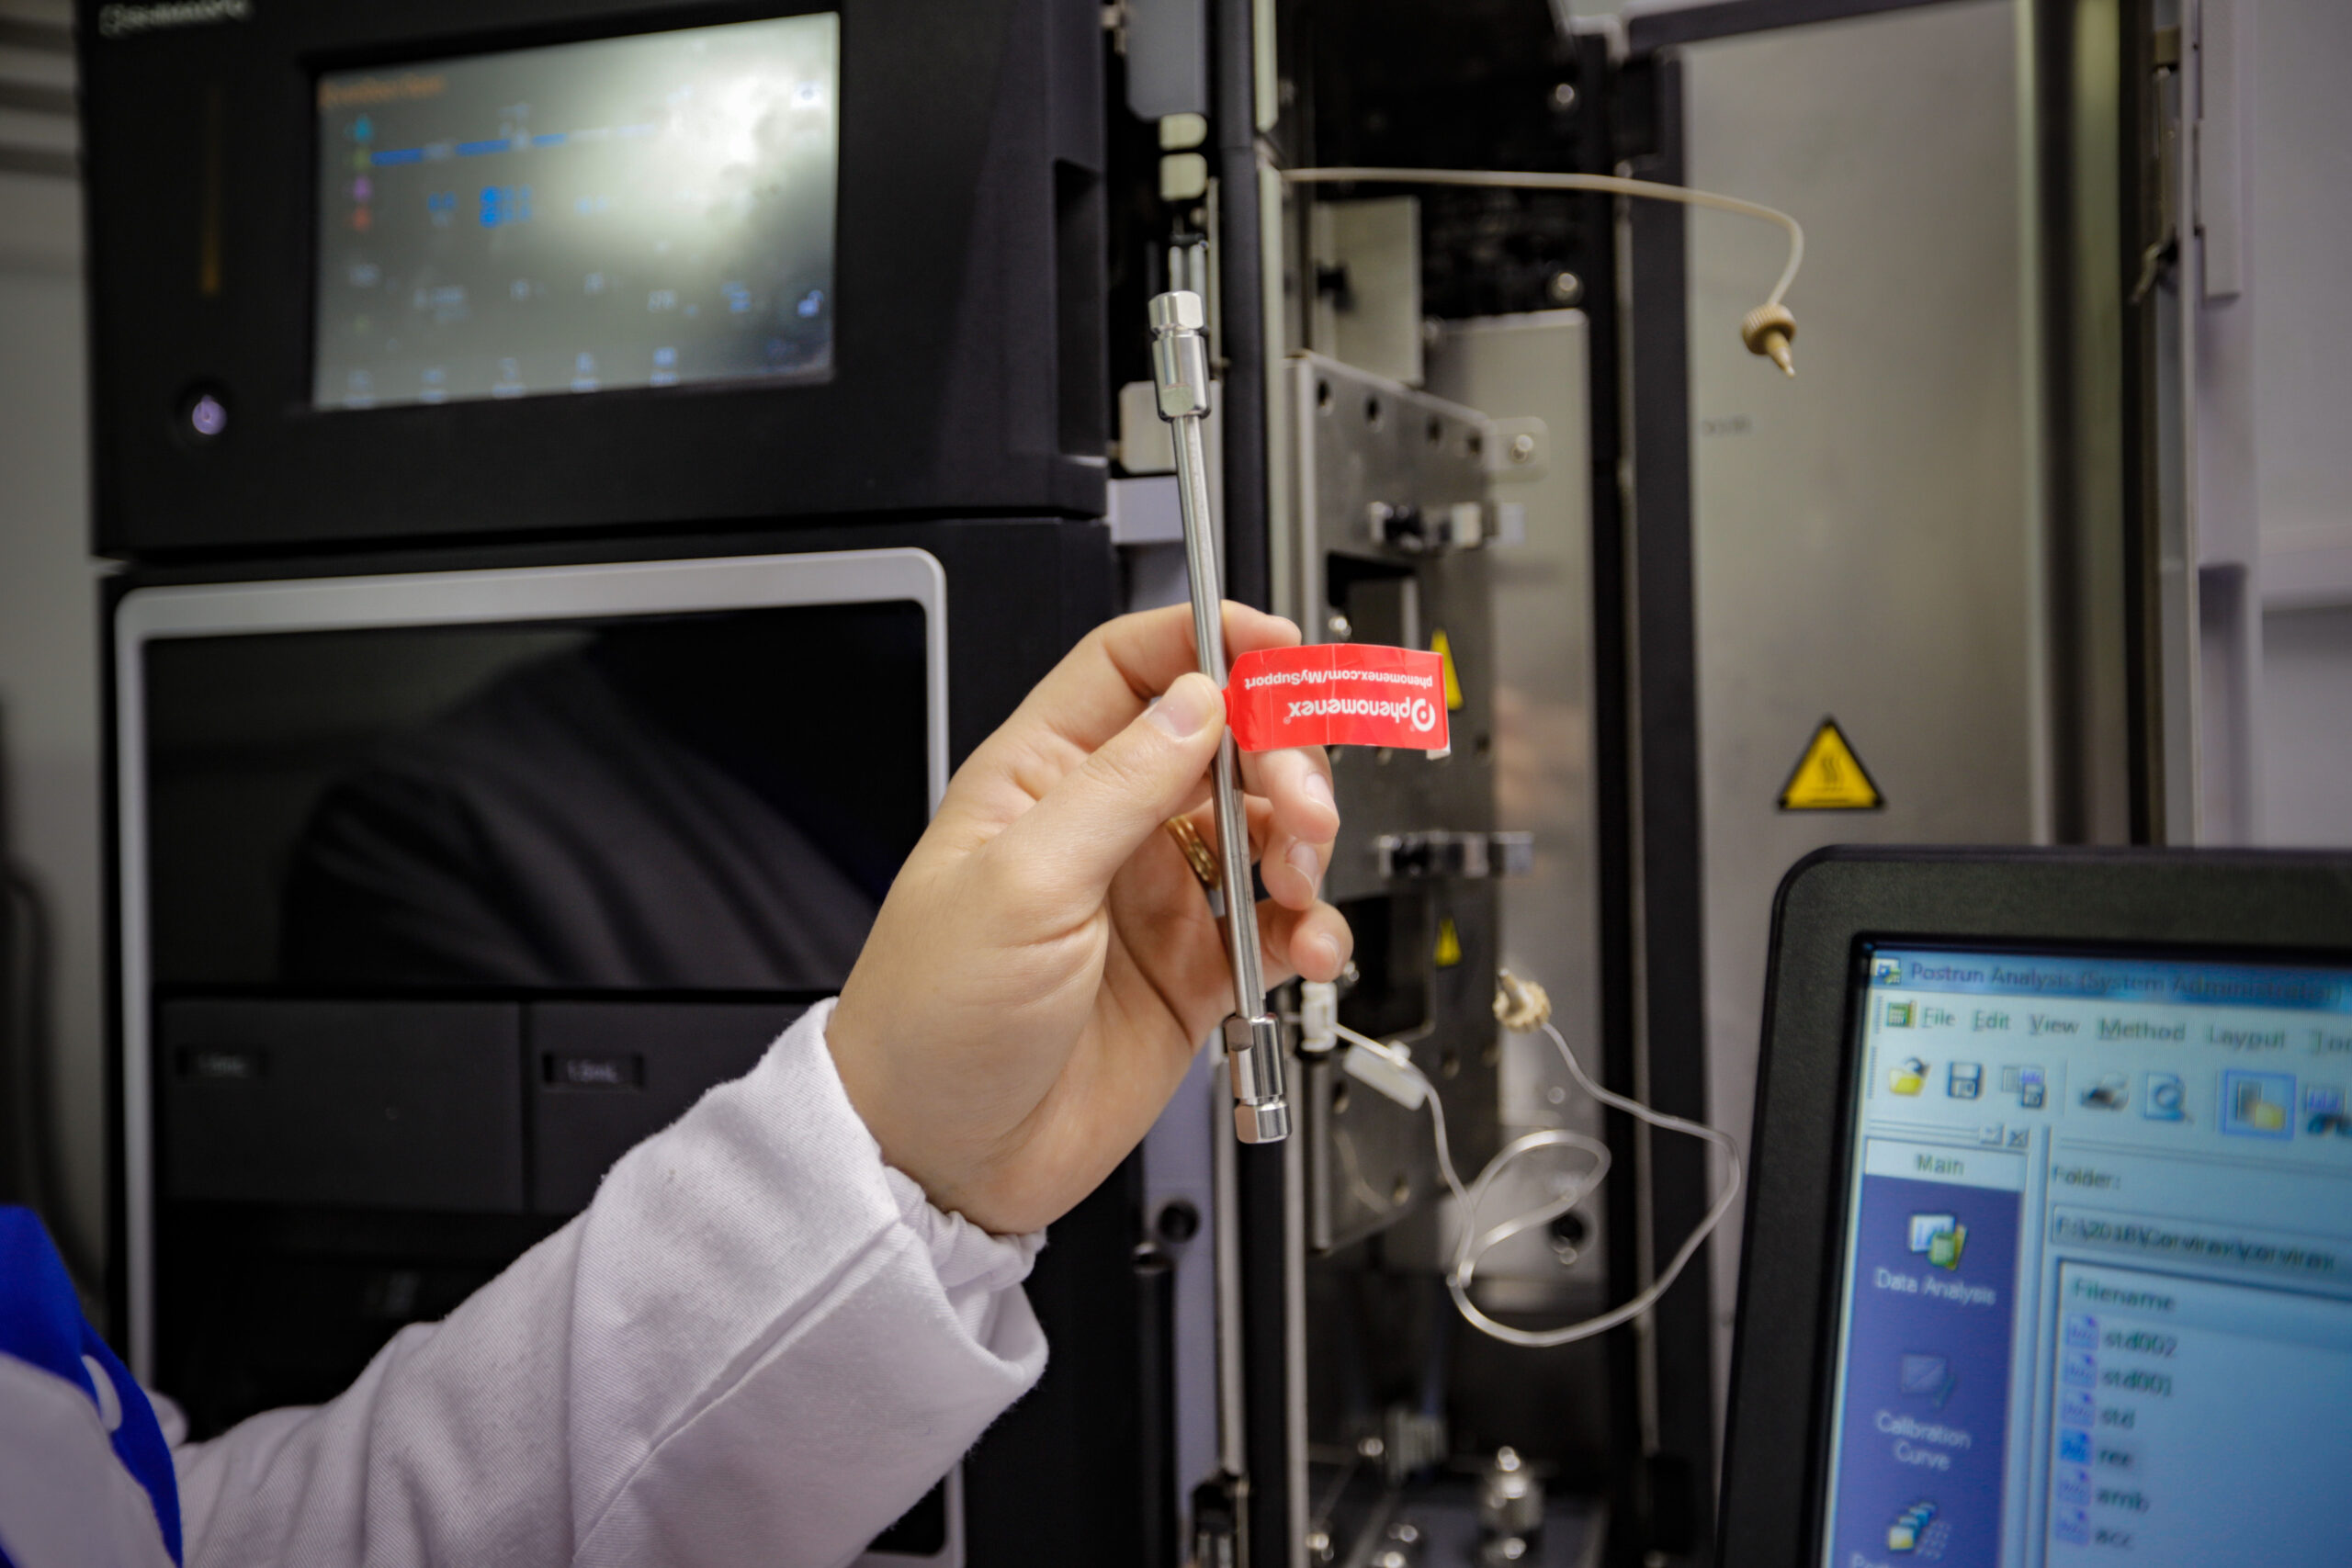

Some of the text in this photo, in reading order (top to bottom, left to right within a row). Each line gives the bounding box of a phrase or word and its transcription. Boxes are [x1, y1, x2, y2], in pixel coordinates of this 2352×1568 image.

[1244, 669, 1433, 689] phenomenex.com/MySupport
[1911, 962, 1984, 984] Postrun
[1992, 967, 2072, 990] Analysis
[1922, 1007, 1956, 1028] File
[1973, 1010, 2011, 1032] Edit
[2030, 1013, 2080, 1035] View
[2098, 1017, 2187, 1041] Method
[2208, 1023, 2286, 1051] Layout
[1915, 1154, 1965, 1176] Main
[2052, 1165, 2121, 1190] Folder:
[1875, 1266, 1996, 1306] Data Analysis
[2074, 1276, 2177, 1312] Filename
[1876, 1410, 1972, 1450] Calibration
[1894, 1440, 1951, 1472] Curve
